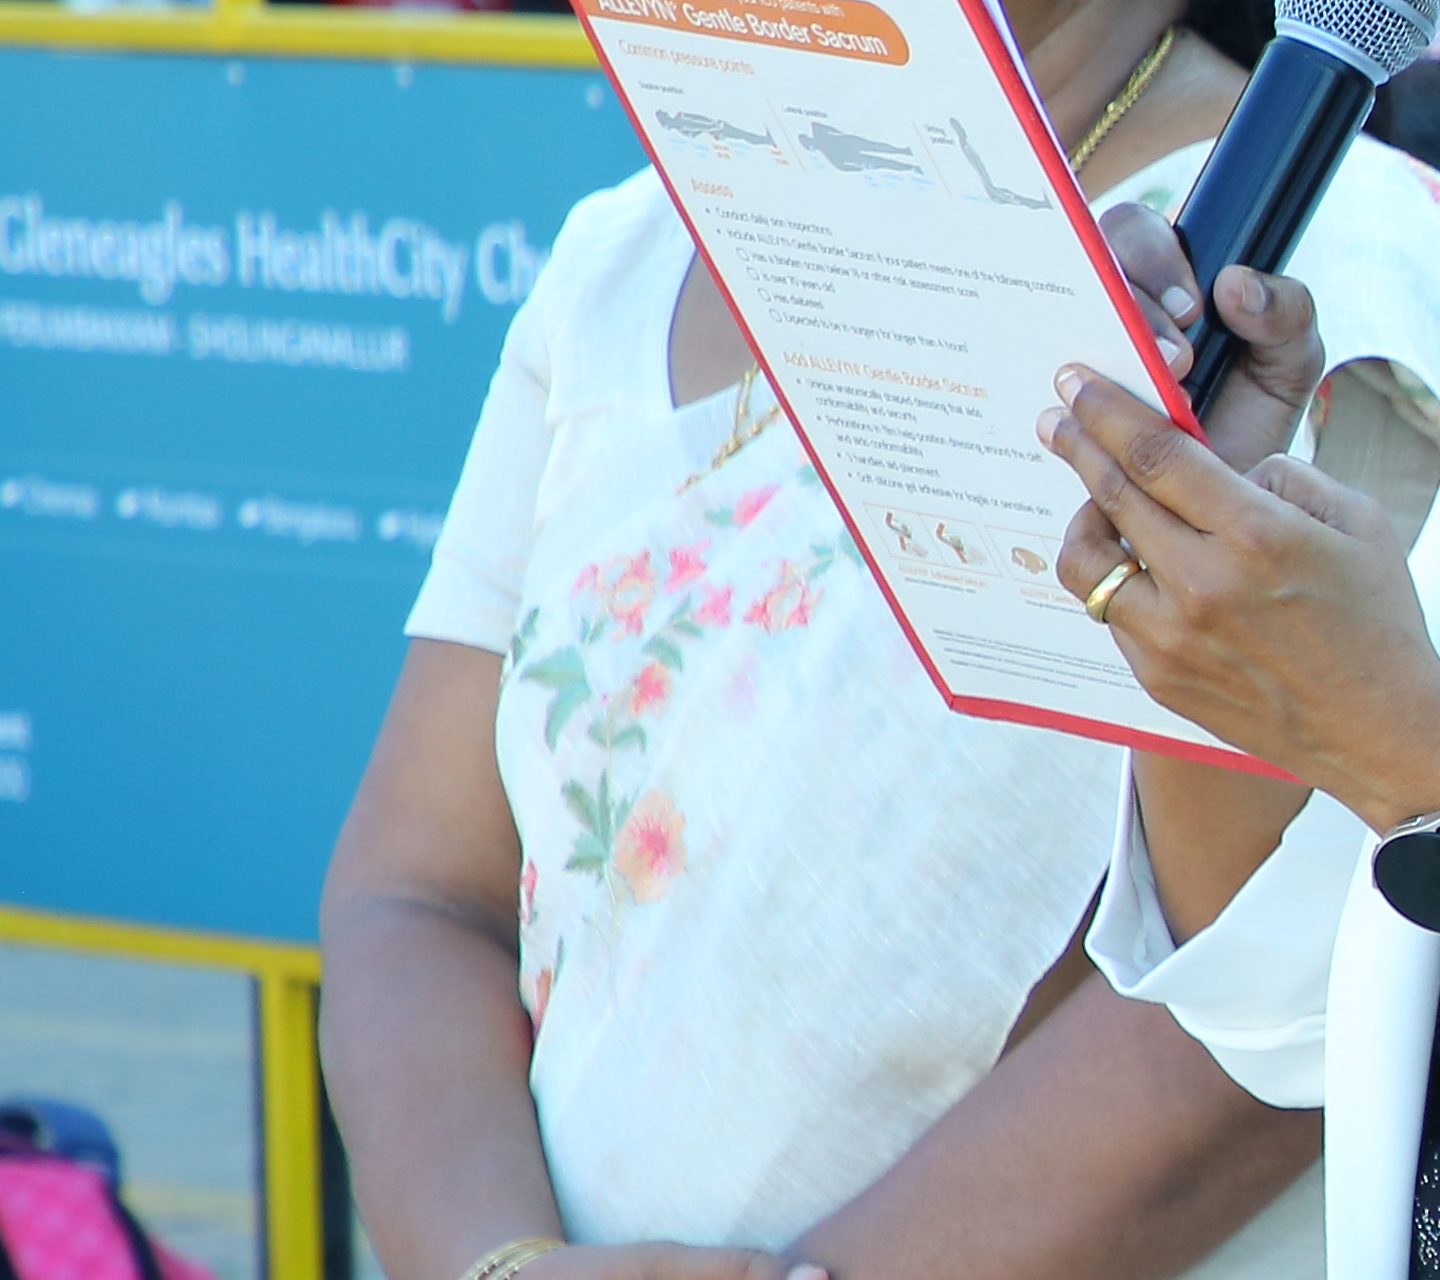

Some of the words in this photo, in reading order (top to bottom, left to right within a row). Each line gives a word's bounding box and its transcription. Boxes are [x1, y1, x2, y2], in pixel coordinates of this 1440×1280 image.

[682, 3, 747, 33] Gentle
[745, 13, 810, 43] Border
[811, 24, 887, 55] Sacrum
[236, 209, 469, 324] HealthCity
